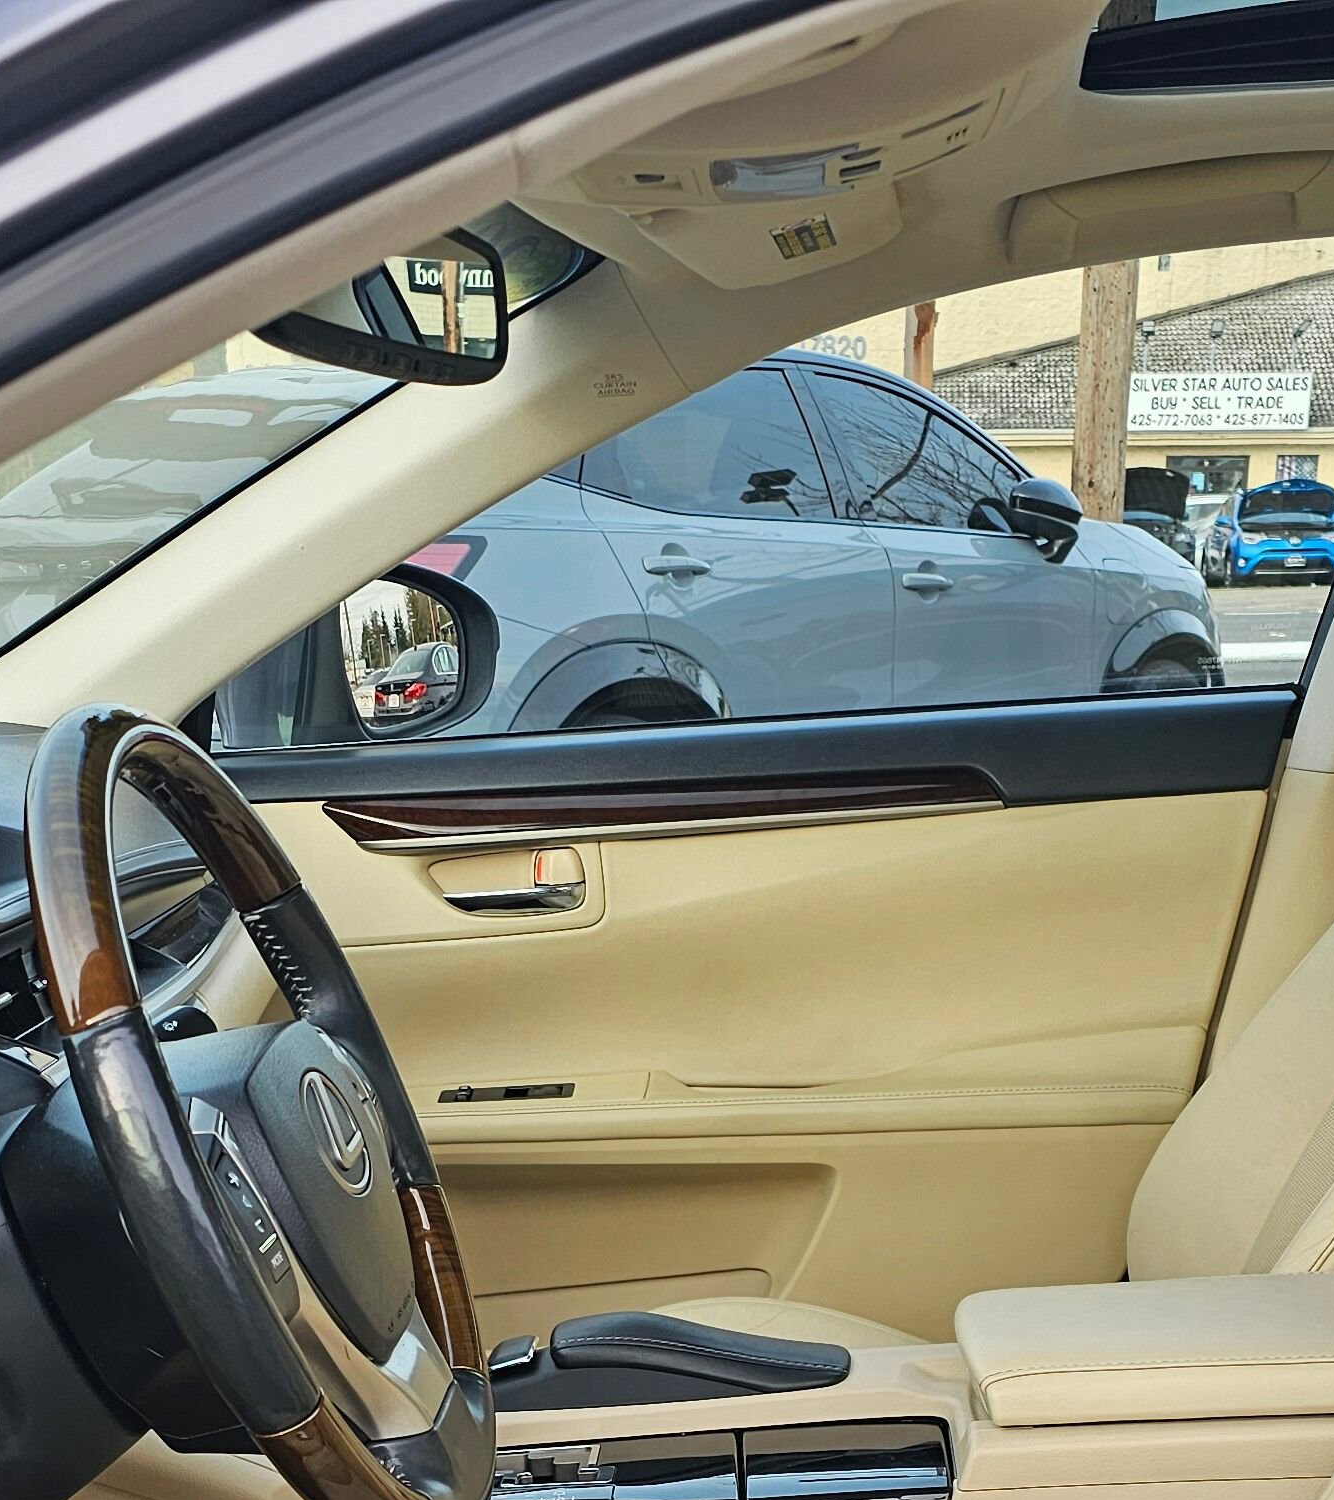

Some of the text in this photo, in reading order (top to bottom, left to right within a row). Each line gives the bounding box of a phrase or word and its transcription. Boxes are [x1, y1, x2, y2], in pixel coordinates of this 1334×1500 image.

[1132, 377, 1310, 392] SILVER STAR AUTO SALES
[1151, 396, 1284, 410] BUY SELL TRADE
